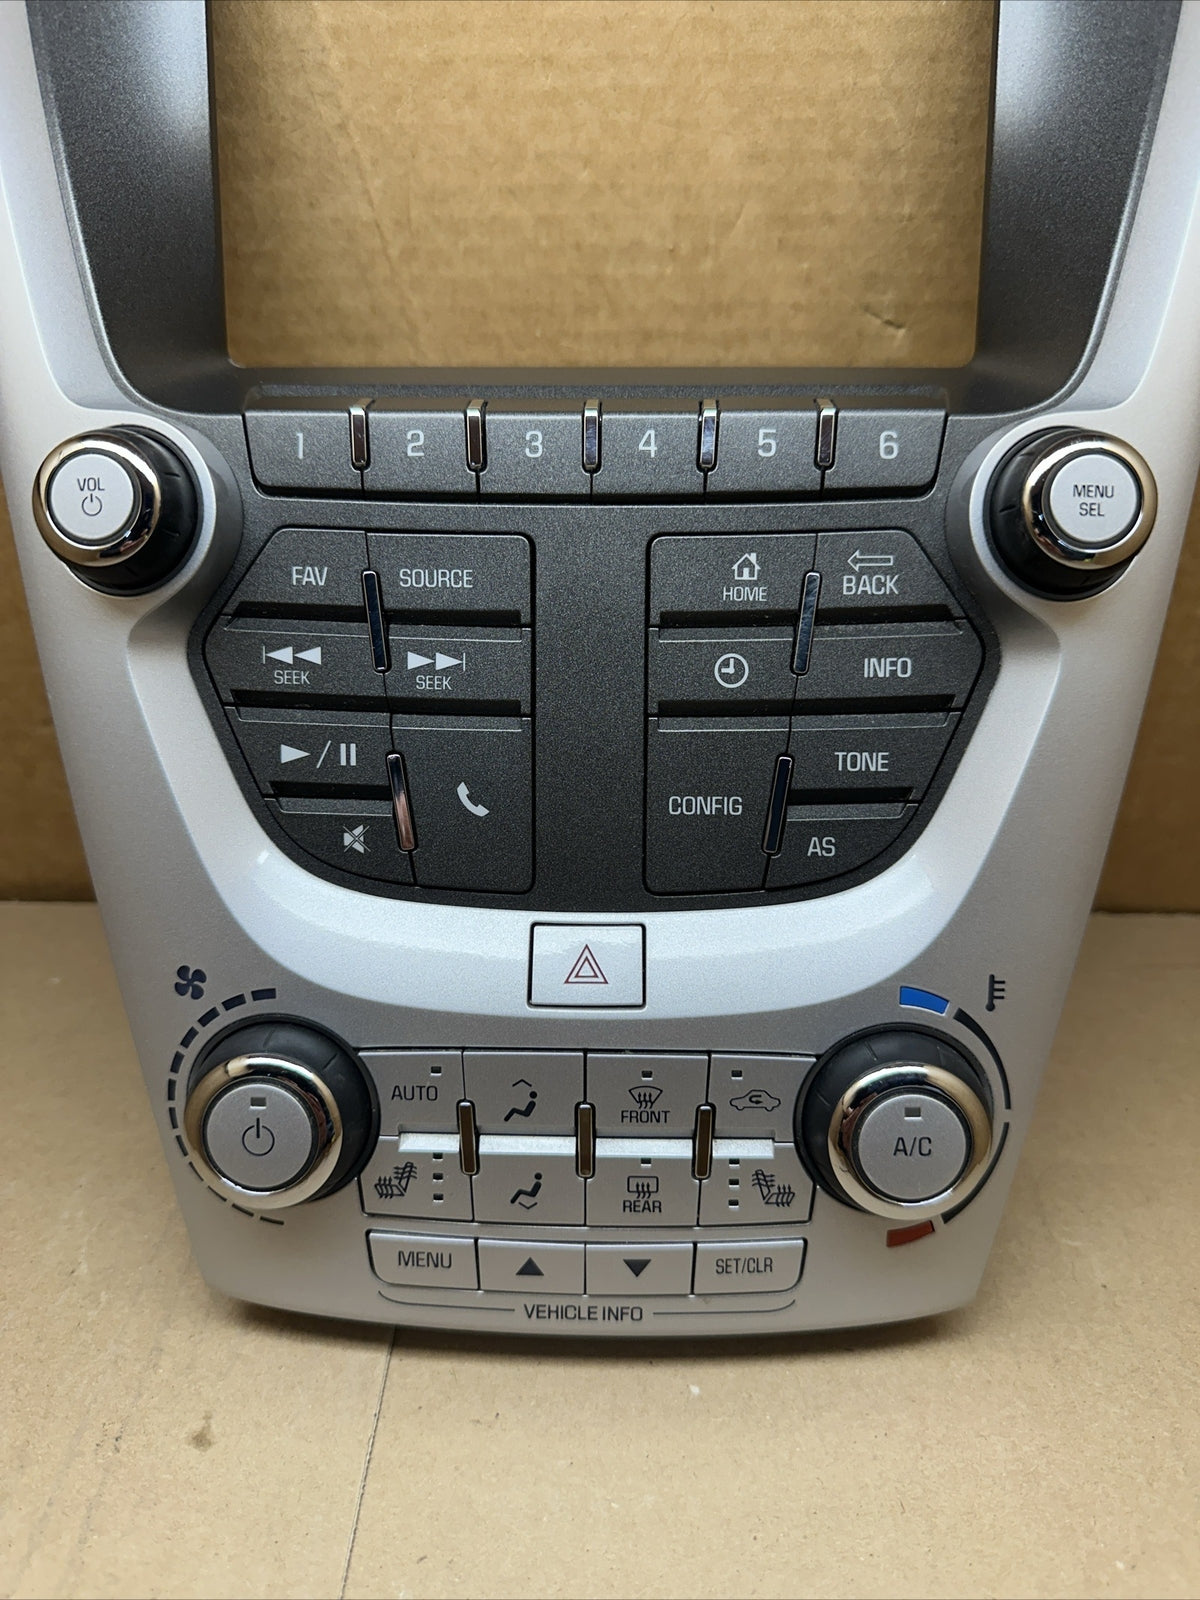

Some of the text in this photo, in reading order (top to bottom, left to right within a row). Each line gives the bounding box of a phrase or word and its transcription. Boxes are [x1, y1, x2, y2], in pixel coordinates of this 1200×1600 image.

[295, 431, 304, 460] 1
[406, 429, 425, 457] 2
[524, 429, 543, 458] 3
[638, 427, 658, 458] 4
[757, 427, 777, 458] 5
[879, 430, 899, 460] 6
[76, 477, 105, 492] VOL
[1072, 484, 1115, 499] MENU
[1078, 501, 1105, 517] SEL
[292, 566, 328, 586] FAV
[399, 568, 473, 588] SOURCE
[842, 574, 900, 596] BACK
[722, 585, 768, 602] HOME
[273, 669, 311, 685] SEEK
[863, 657, 912, 678] INFO
[415, 674, 453, 691] SEEK
[834, 751, 890, 772] TONE
[668, 795, 743, 816] CONFIG
[807, 836, 836, 857] AS
[391, 1085, 438, 1102] AUTO
[620, 1109, 671, 1124] FRONT
[892, 1136, 932, 1157] A/C
[622, 1199, 662, 1214] REAR
[397, 1250, 452, 1270] MENU
[715, 1256, 774, 1275] SET/CLR
[524, 1304, 643, 1322] VEHICLE INFO
